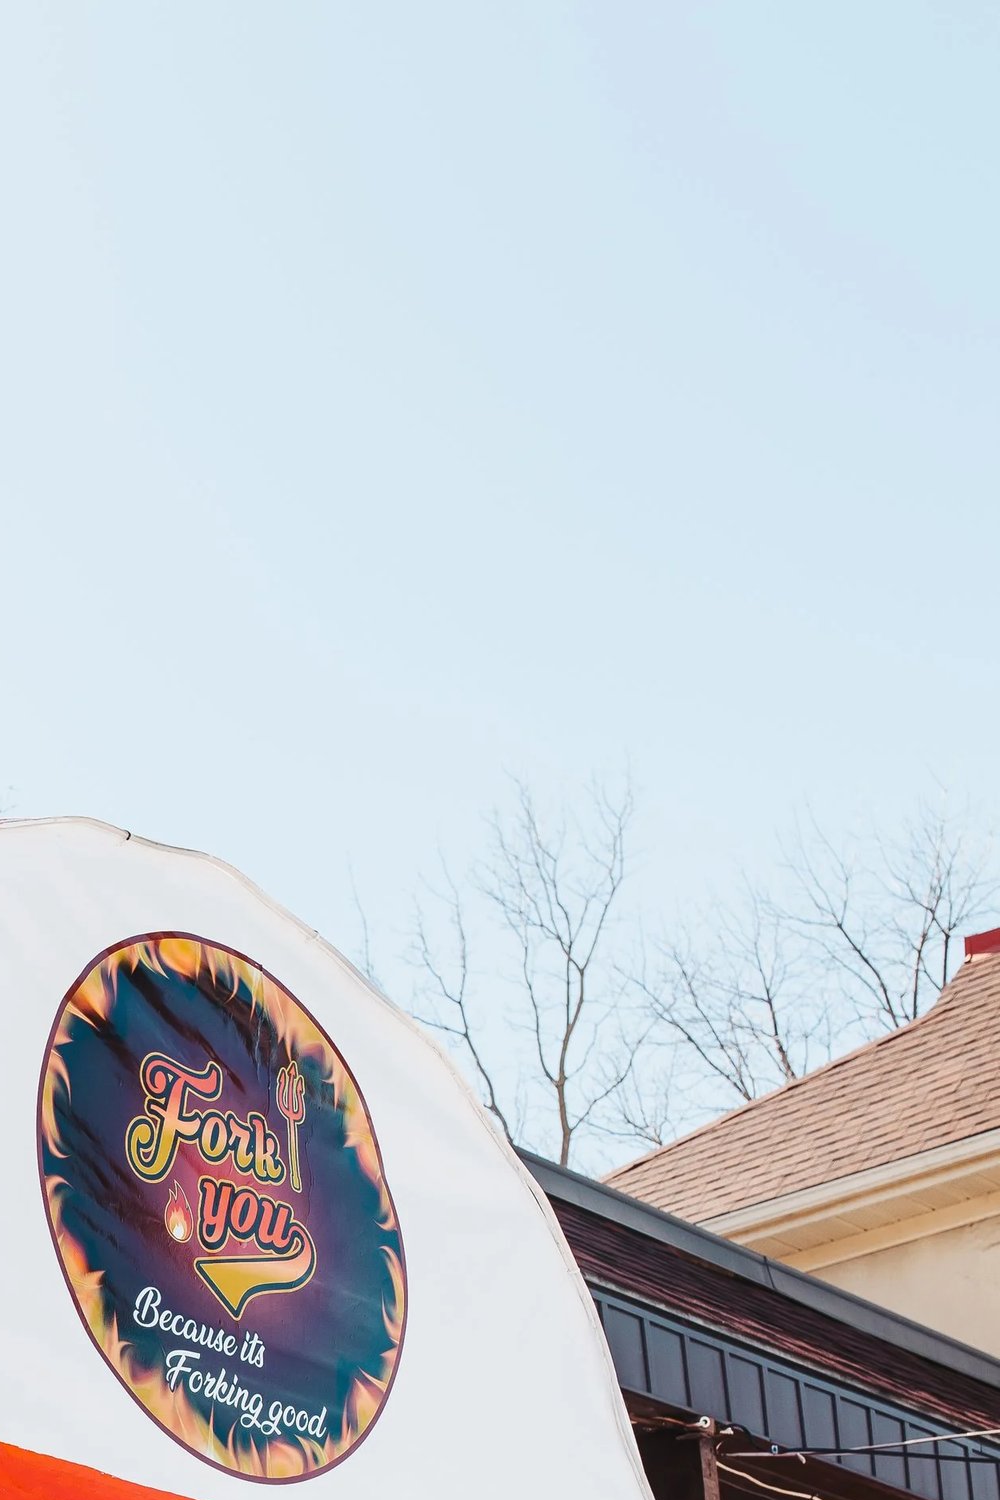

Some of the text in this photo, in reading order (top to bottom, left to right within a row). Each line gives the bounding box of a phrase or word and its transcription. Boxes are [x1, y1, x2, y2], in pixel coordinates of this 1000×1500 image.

[126, 1053, 286, 1184] Fork
[199, 1177, 297, 1254] you
[133, 1286, 266, 1368] Because its
[165, 1349, 328, 1438] Forking good
